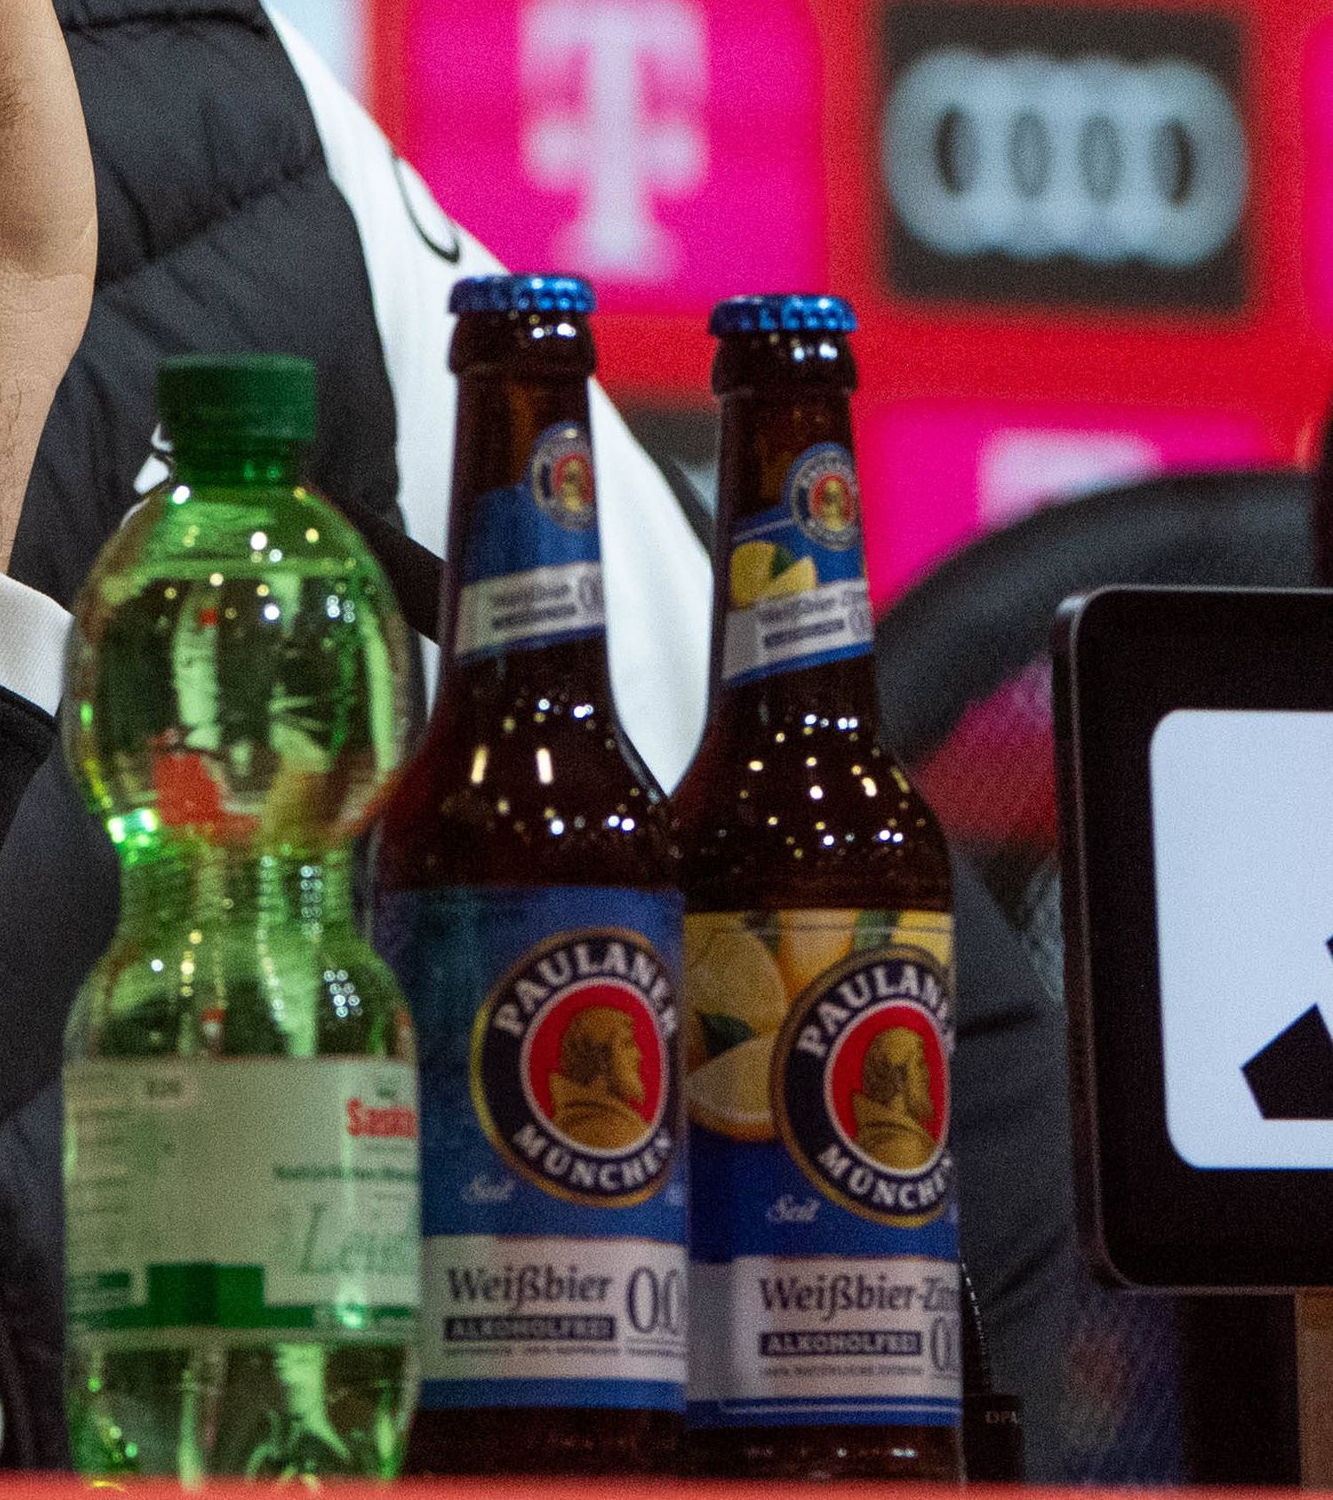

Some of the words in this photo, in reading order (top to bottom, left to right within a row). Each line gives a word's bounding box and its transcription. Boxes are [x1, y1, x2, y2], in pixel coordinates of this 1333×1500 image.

[446, 1261, 612, 1311] Weißbier
[448, 1318, 613, 1340] ALKOHOLFREI
[764, 1334, 919, 1353] ALKOHOLFREI
